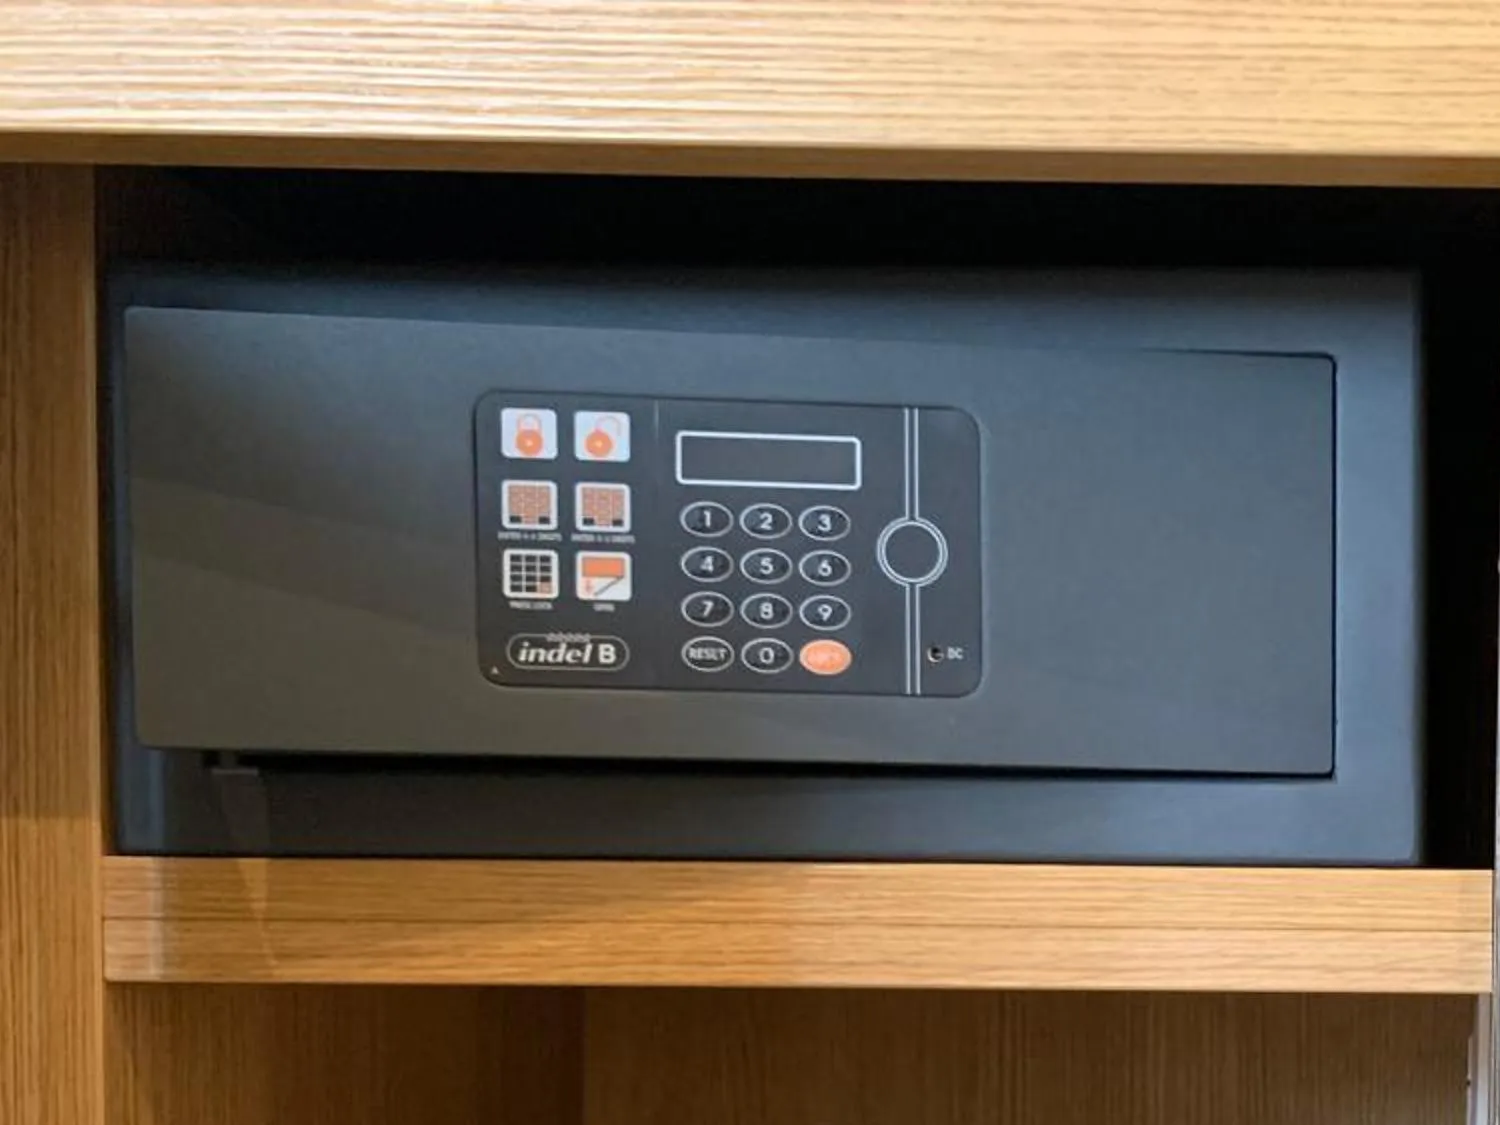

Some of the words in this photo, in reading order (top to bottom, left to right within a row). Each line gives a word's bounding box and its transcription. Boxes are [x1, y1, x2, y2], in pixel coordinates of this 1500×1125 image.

[759, 513, 772, 530] 2
[817, 515, 831, 532] 3
[700, 556, 714, 573] 4
[760, 558, 773, 575] 5
[817, 560, 831, 577] 6
[701, 601, 714, 617] 7
[760, 603, 773, 620] 8
[818, 605, 832, 621] 9
[518, 641, 593, 664] indel
[598, 643, 617, 664] B
[689, 648, 727, 661] RESET
[760, 648, 774, 665] 0
